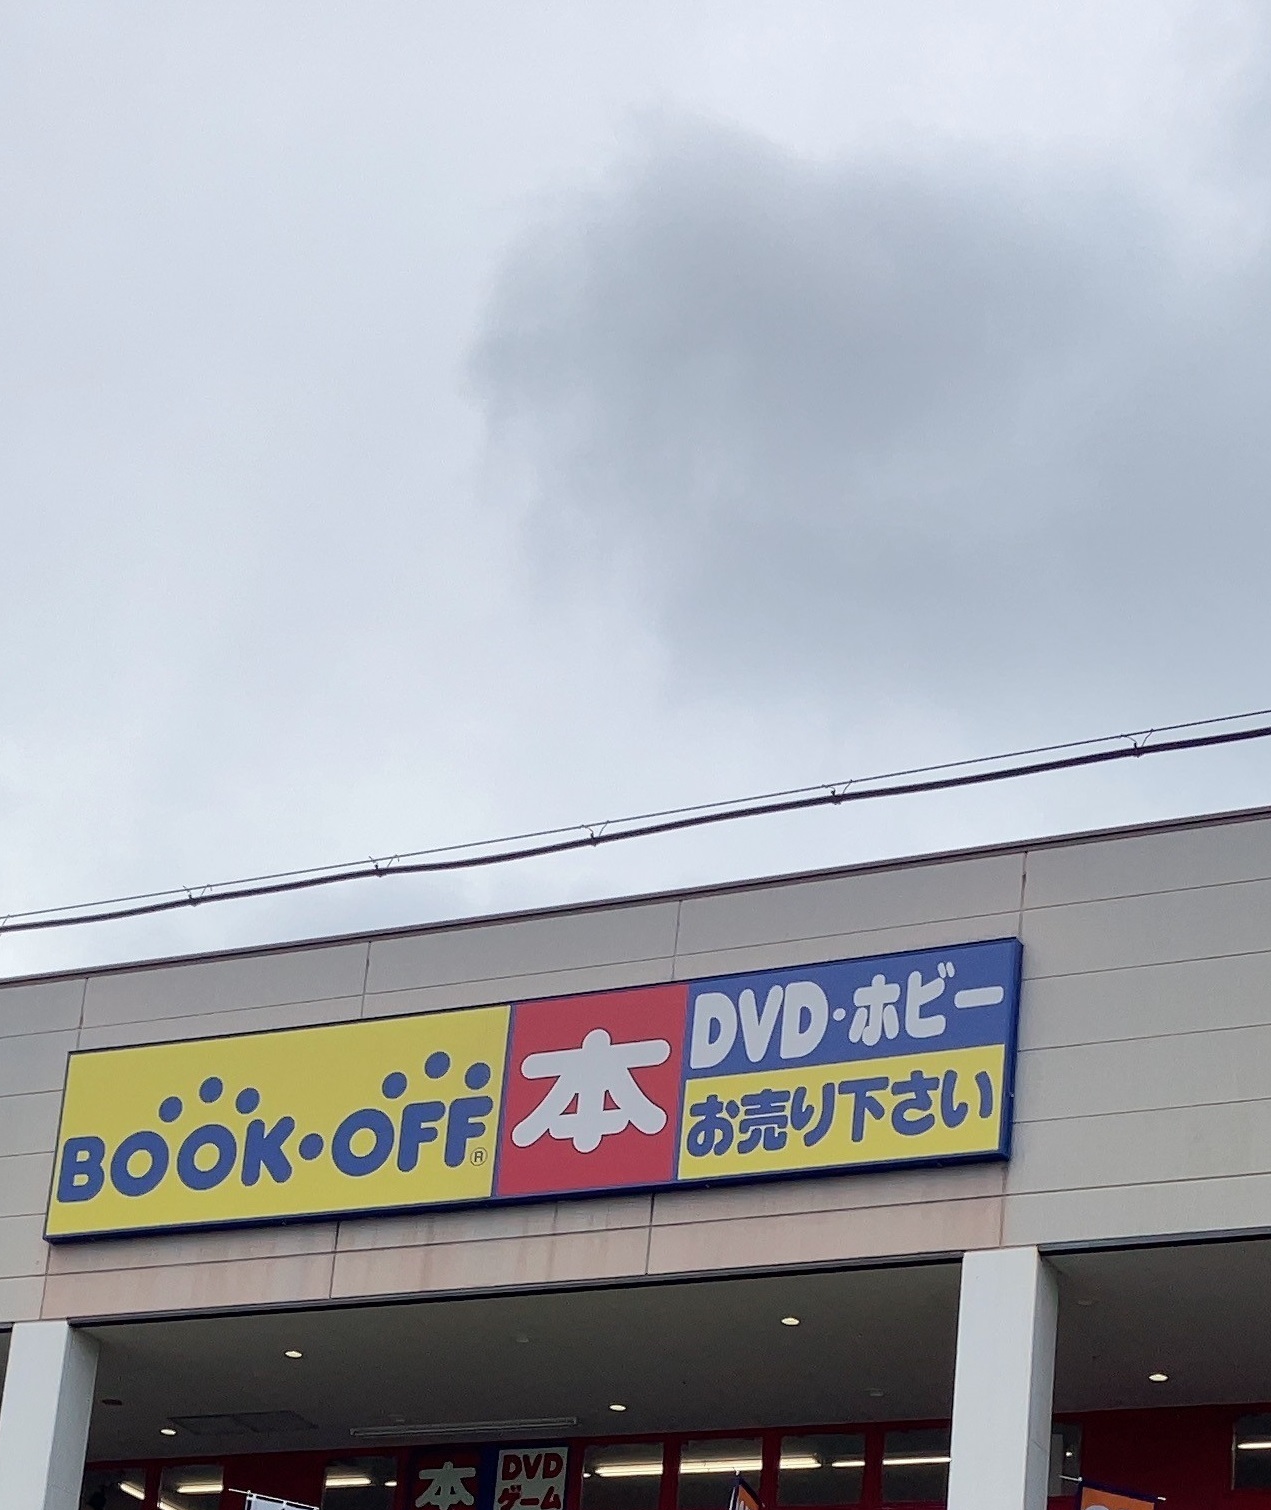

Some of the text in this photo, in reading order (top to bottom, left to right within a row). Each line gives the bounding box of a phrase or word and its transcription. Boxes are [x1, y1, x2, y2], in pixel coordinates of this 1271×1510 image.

[510, 1028, 672, 1154] 本
[686, 1070, 994, 1158] お売り下さい
[502, 1452, 564, 1481] DVD
